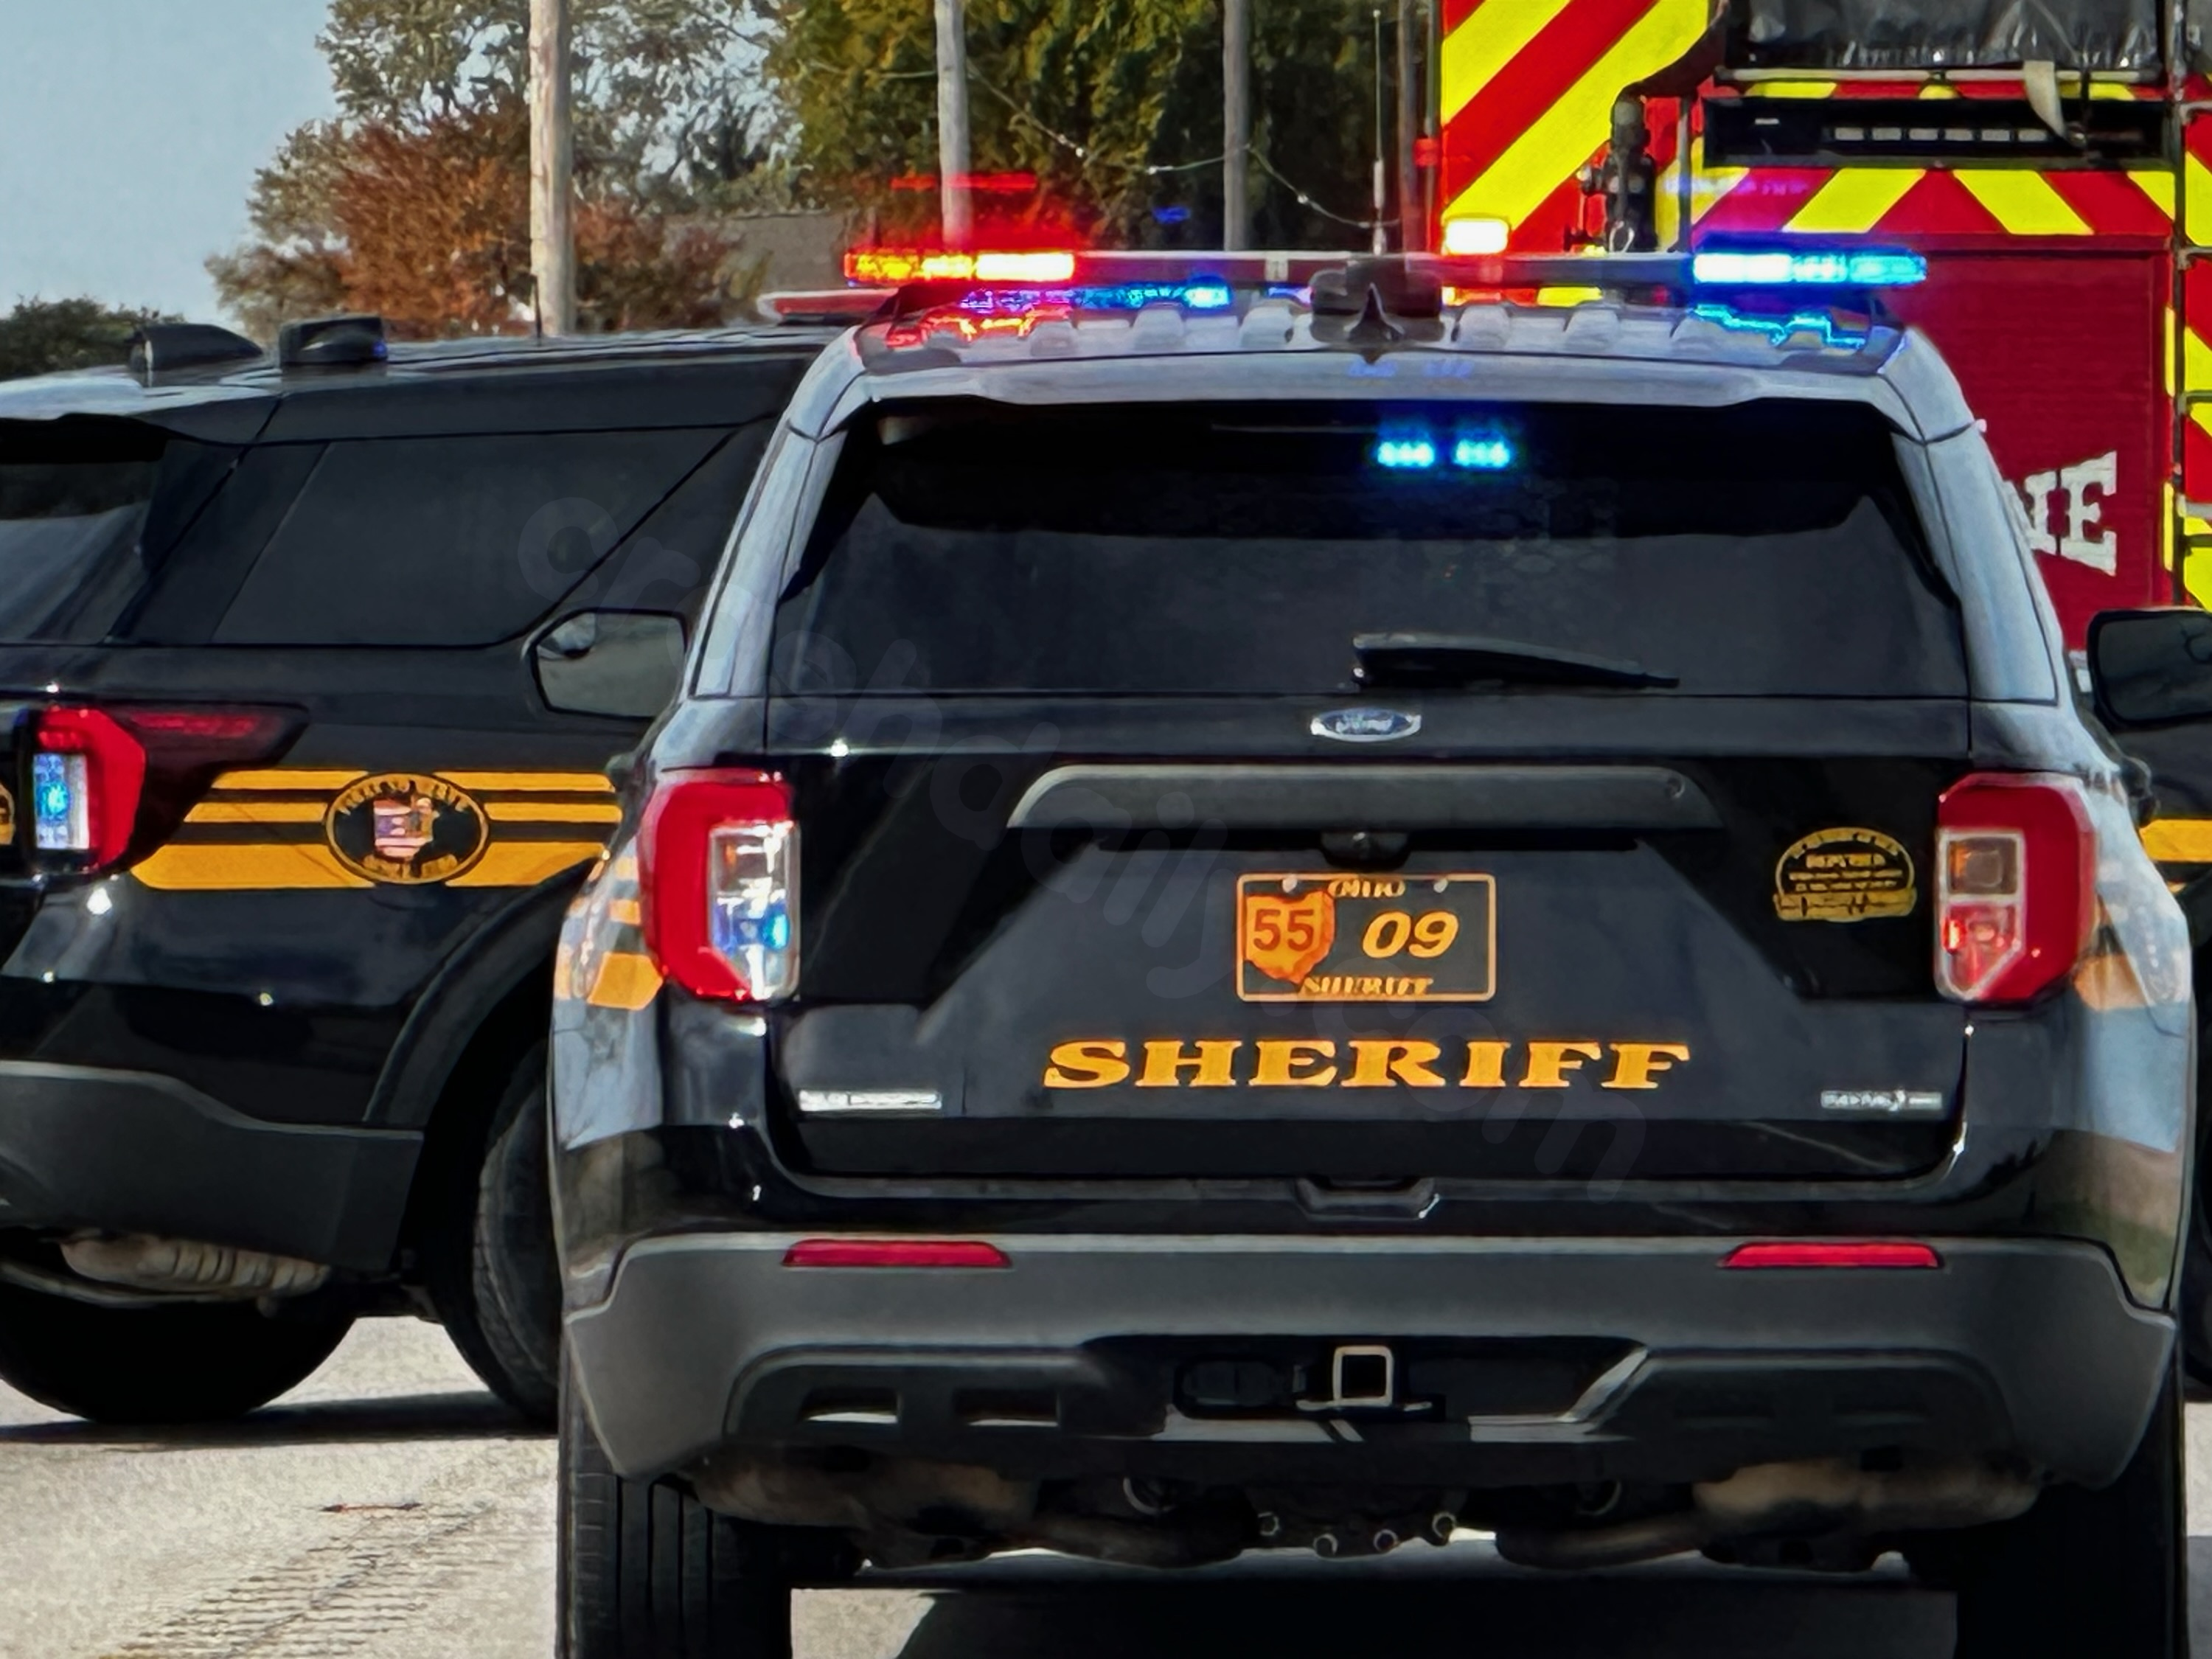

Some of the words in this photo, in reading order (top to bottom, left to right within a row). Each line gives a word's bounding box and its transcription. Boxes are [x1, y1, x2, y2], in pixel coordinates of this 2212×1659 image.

[1253, 908, 1315, 952] 55
[1362, 910, 1459, 959] 09
[1043, 1040, 1690, 1088] SHERIFF
